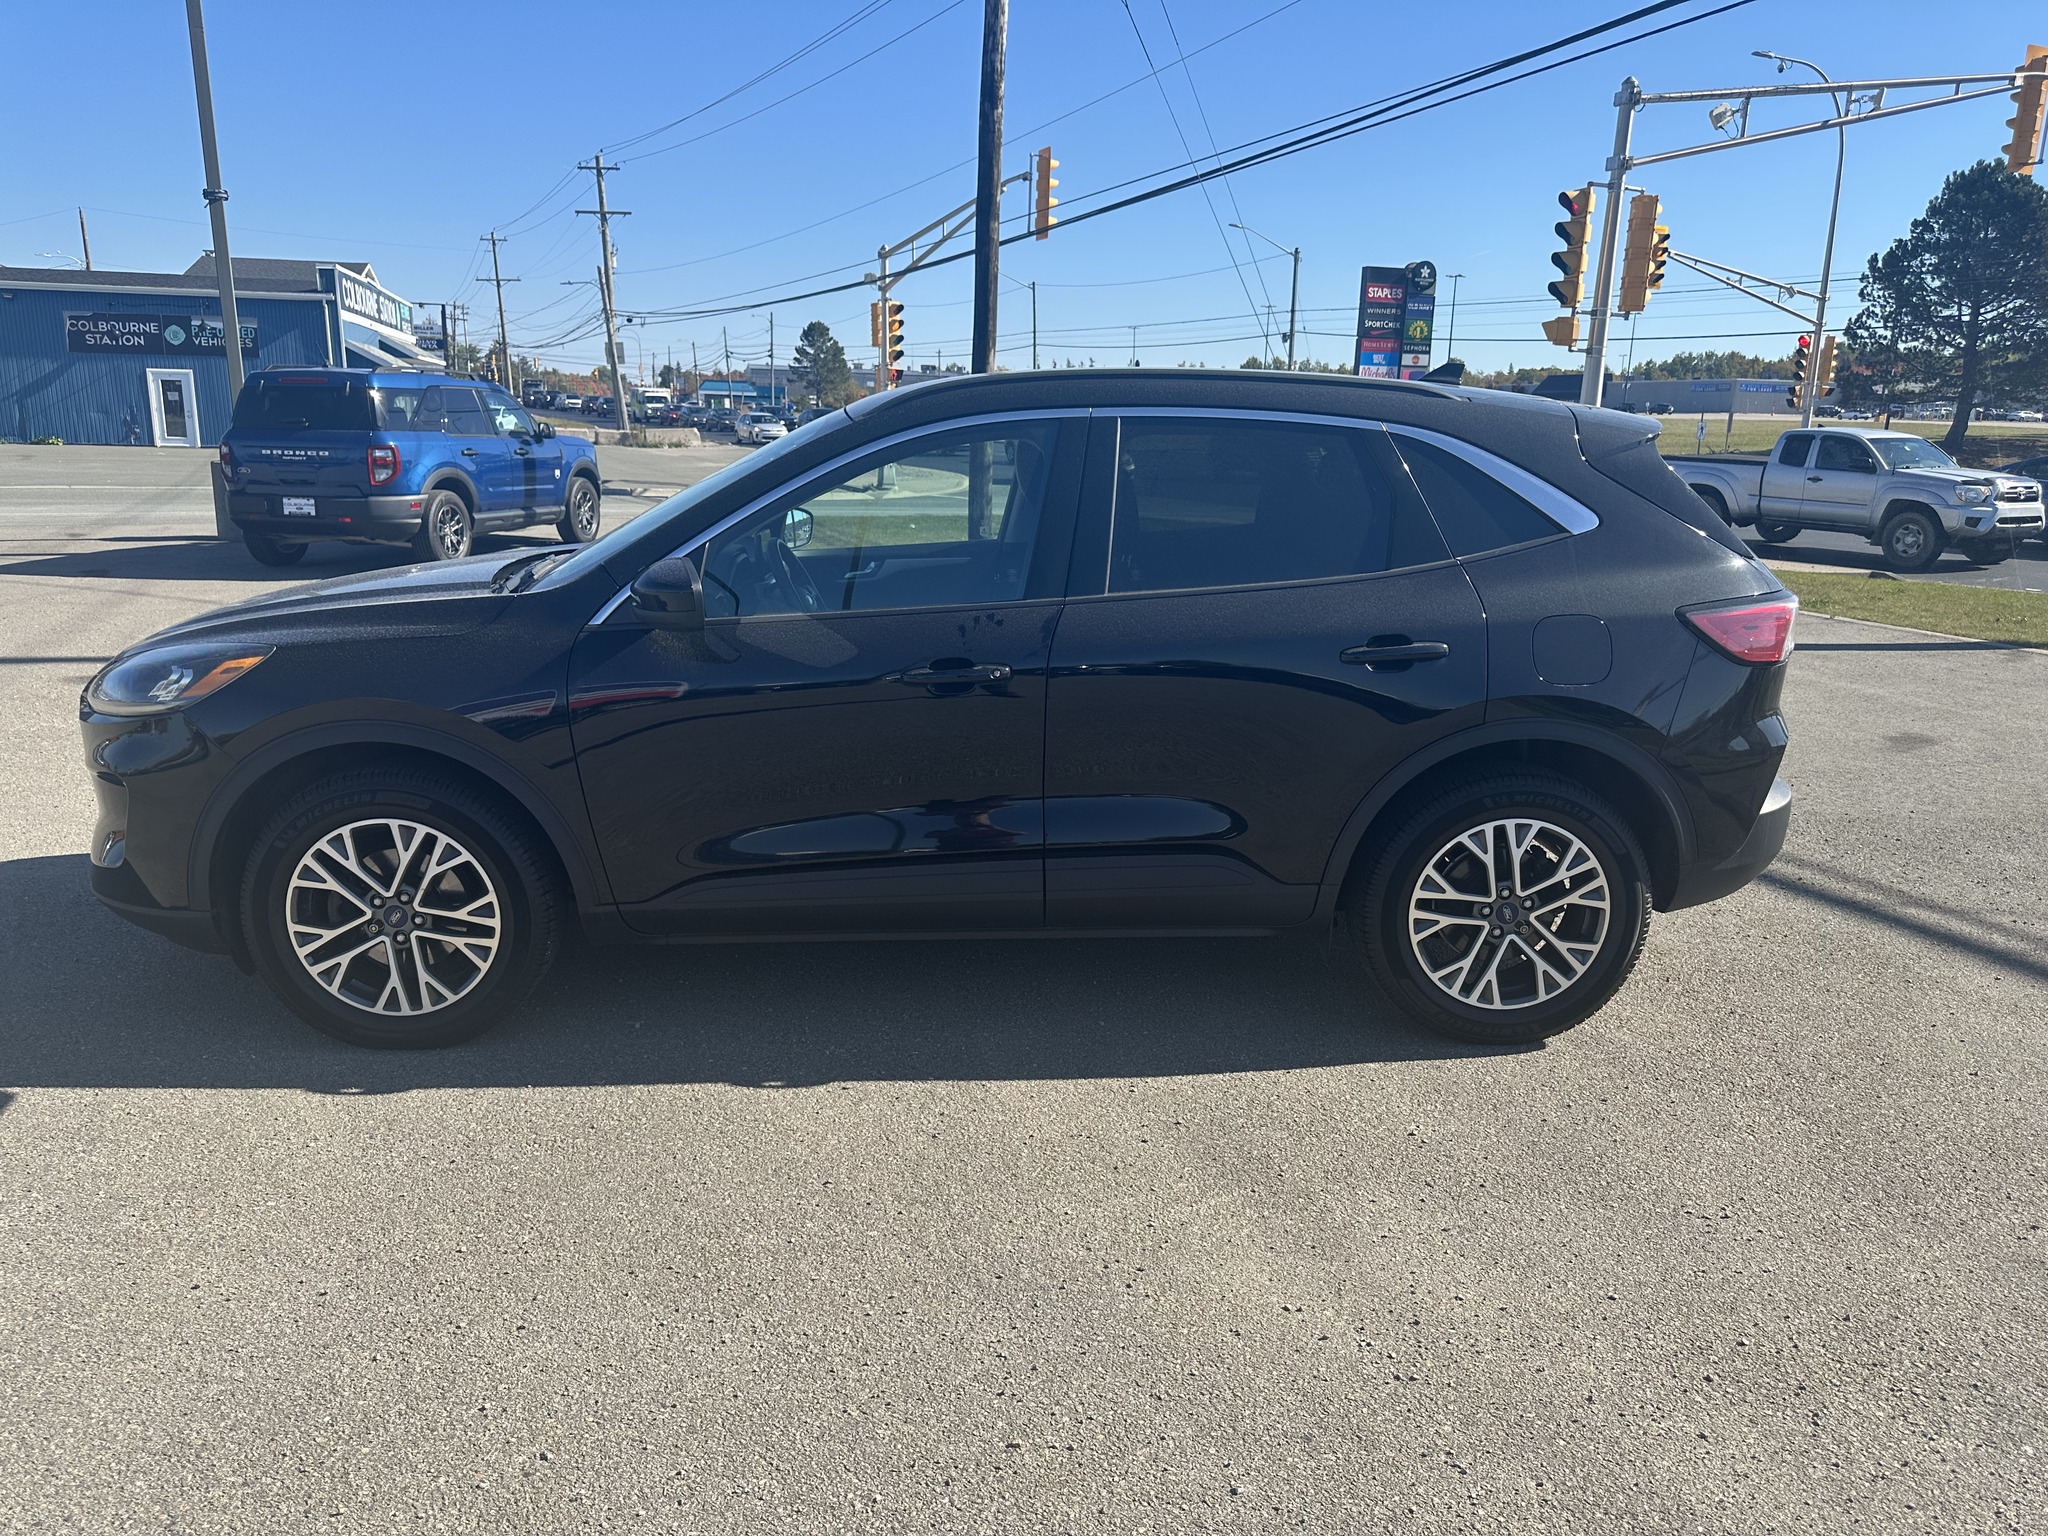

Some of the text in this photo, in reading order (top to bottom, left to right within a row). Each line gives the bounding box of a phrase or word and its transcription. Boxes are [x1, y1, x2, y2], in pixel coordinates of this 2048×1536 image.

[1368, 287, 1402, 299] STAPLES
[68, 319, 159, 333] COLBOURNE
[192, 337, 253, 348] VEHICES
